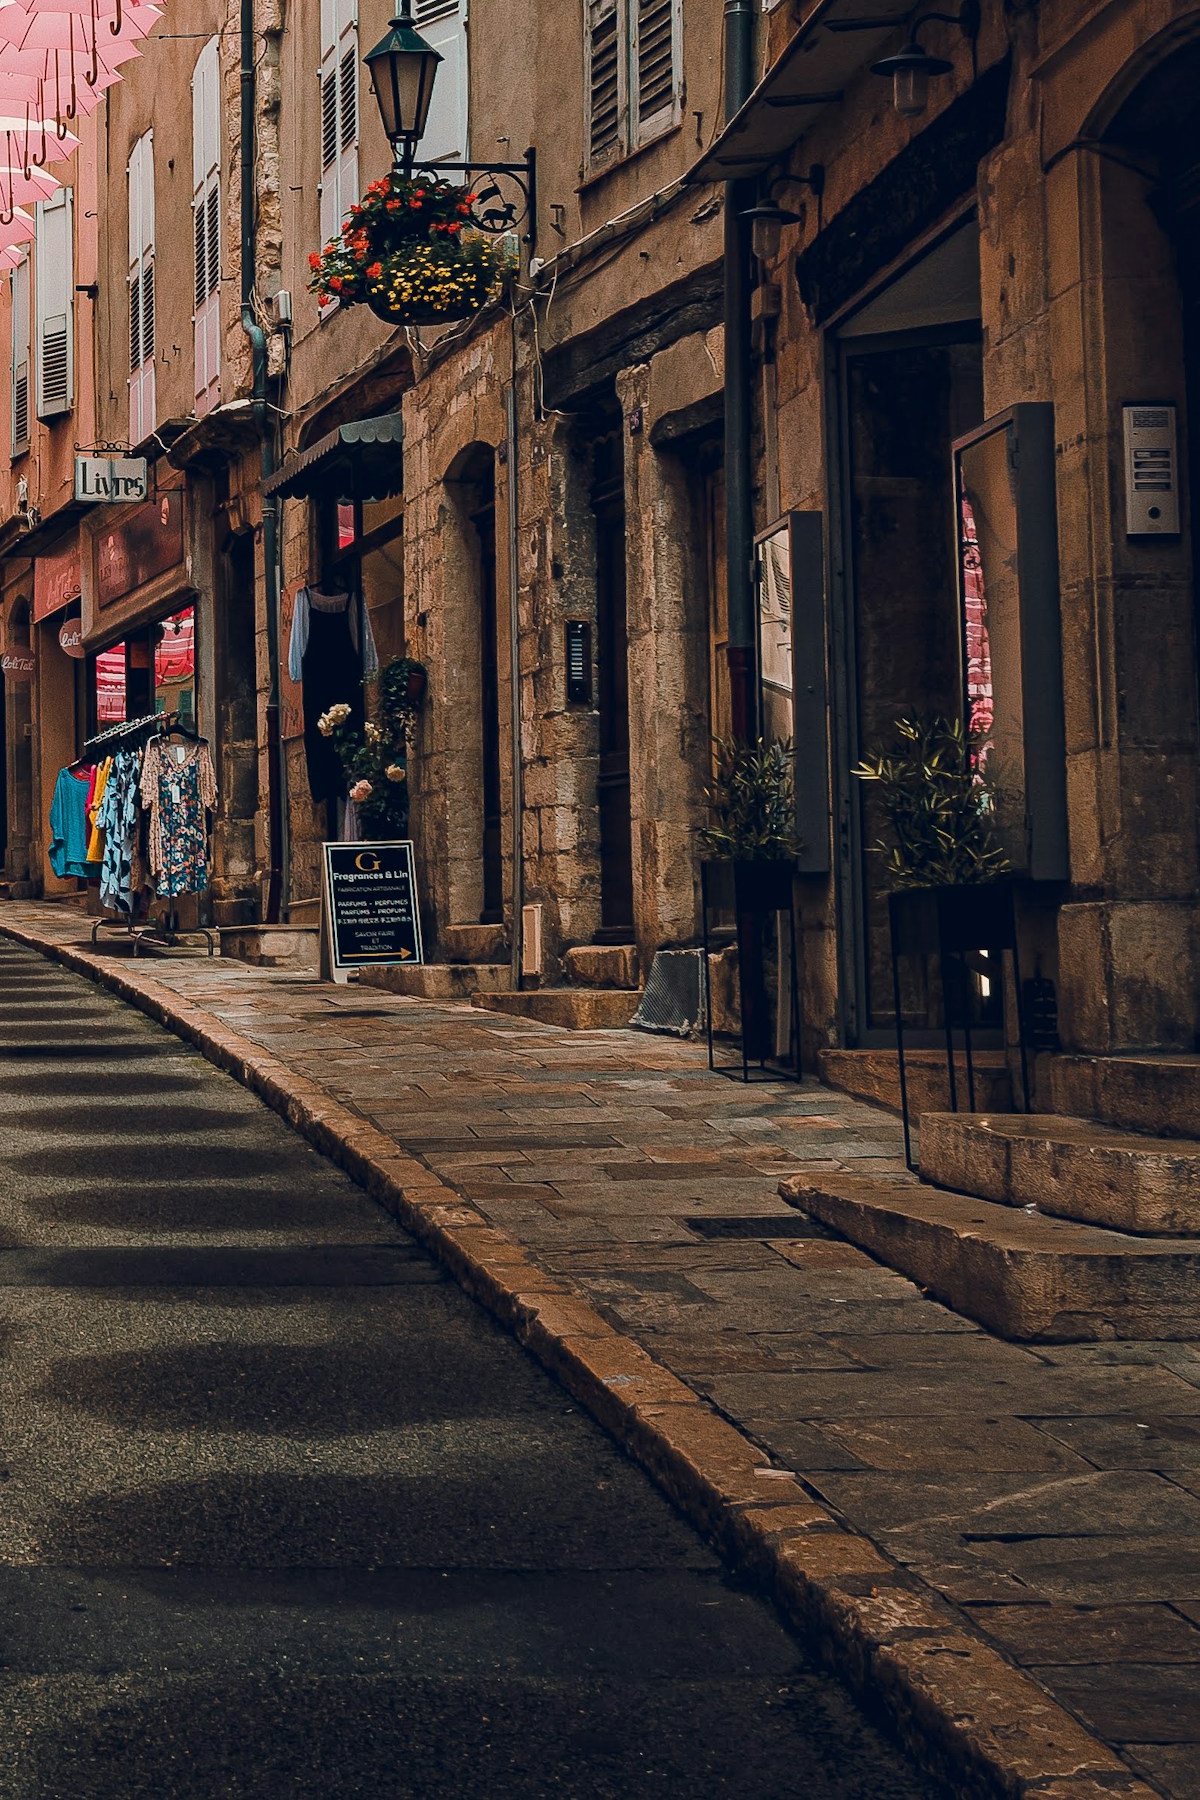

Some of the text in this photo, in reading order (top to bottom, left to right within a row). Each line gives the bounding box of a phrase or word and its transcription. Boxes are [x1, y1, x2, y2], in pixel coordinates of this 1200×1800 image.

[80, 461, 144, 498] Livres
[355, 851, 381, 872] G
[333, 870, 409, 883] Fragrances & Lin
